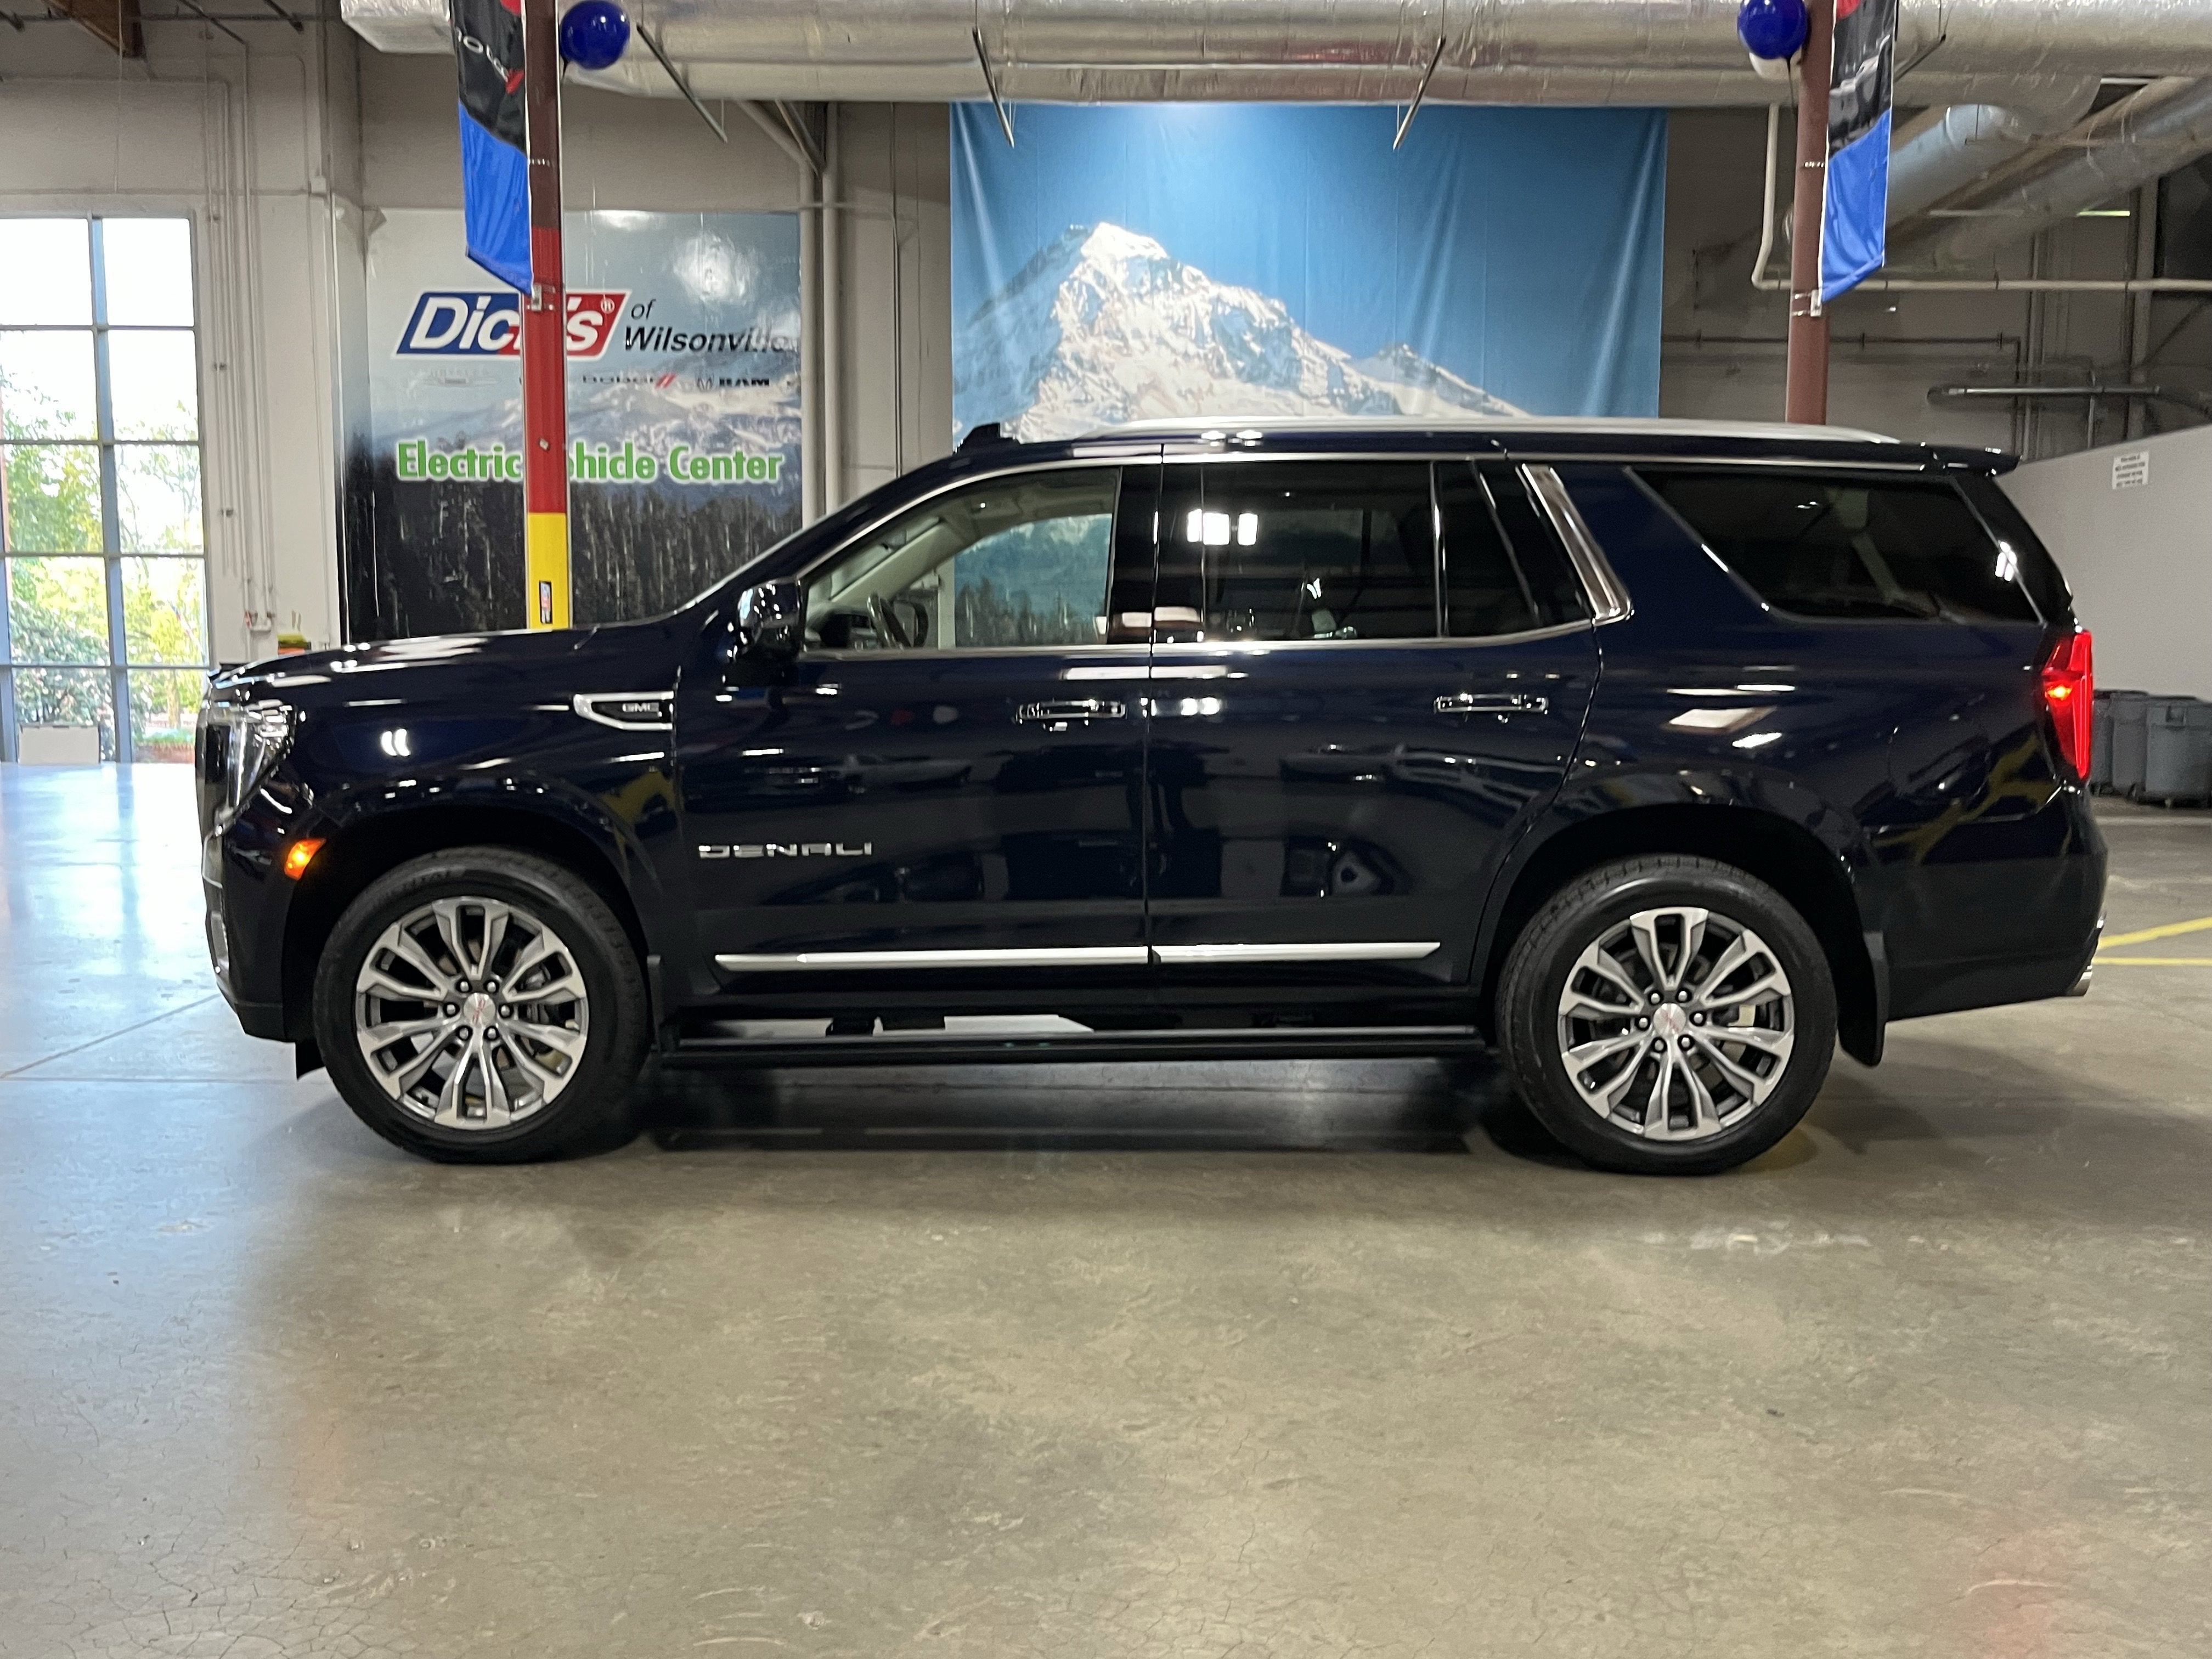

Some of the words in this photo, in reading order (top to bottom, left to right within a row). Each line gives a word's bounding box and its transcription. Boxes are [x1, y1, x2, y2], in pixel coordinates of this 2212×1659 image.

[410, 295, 603, 351] Dic's
[631, 299, 656, 319] of
[398, 440, 521, 478] Electric
[569, 442, 655, 479] hicle
[670, 447, 783, 480] Center
[698, 842, 872, 859] DENALI
